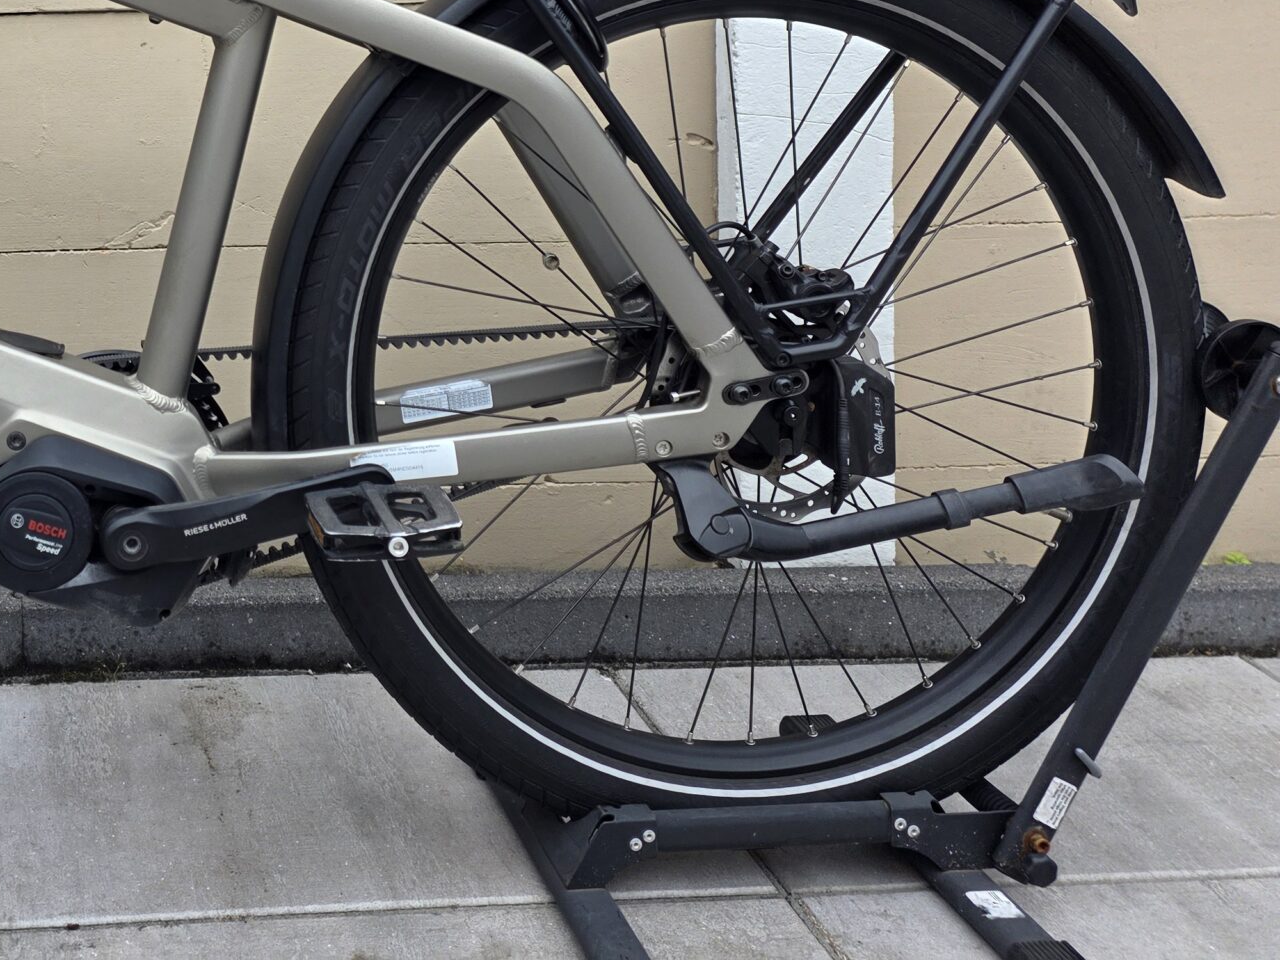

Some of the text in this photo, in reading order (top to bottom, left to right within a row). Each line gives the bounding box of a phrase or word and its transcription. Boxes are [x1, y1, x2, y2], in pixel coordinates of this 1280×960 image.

[873, 419, 886, 454] Rohloff
[28, 519, 67, 539] BOSCH
[183, 524, 210, 537] RIESE
[36, 543, 62, 556] Speed
